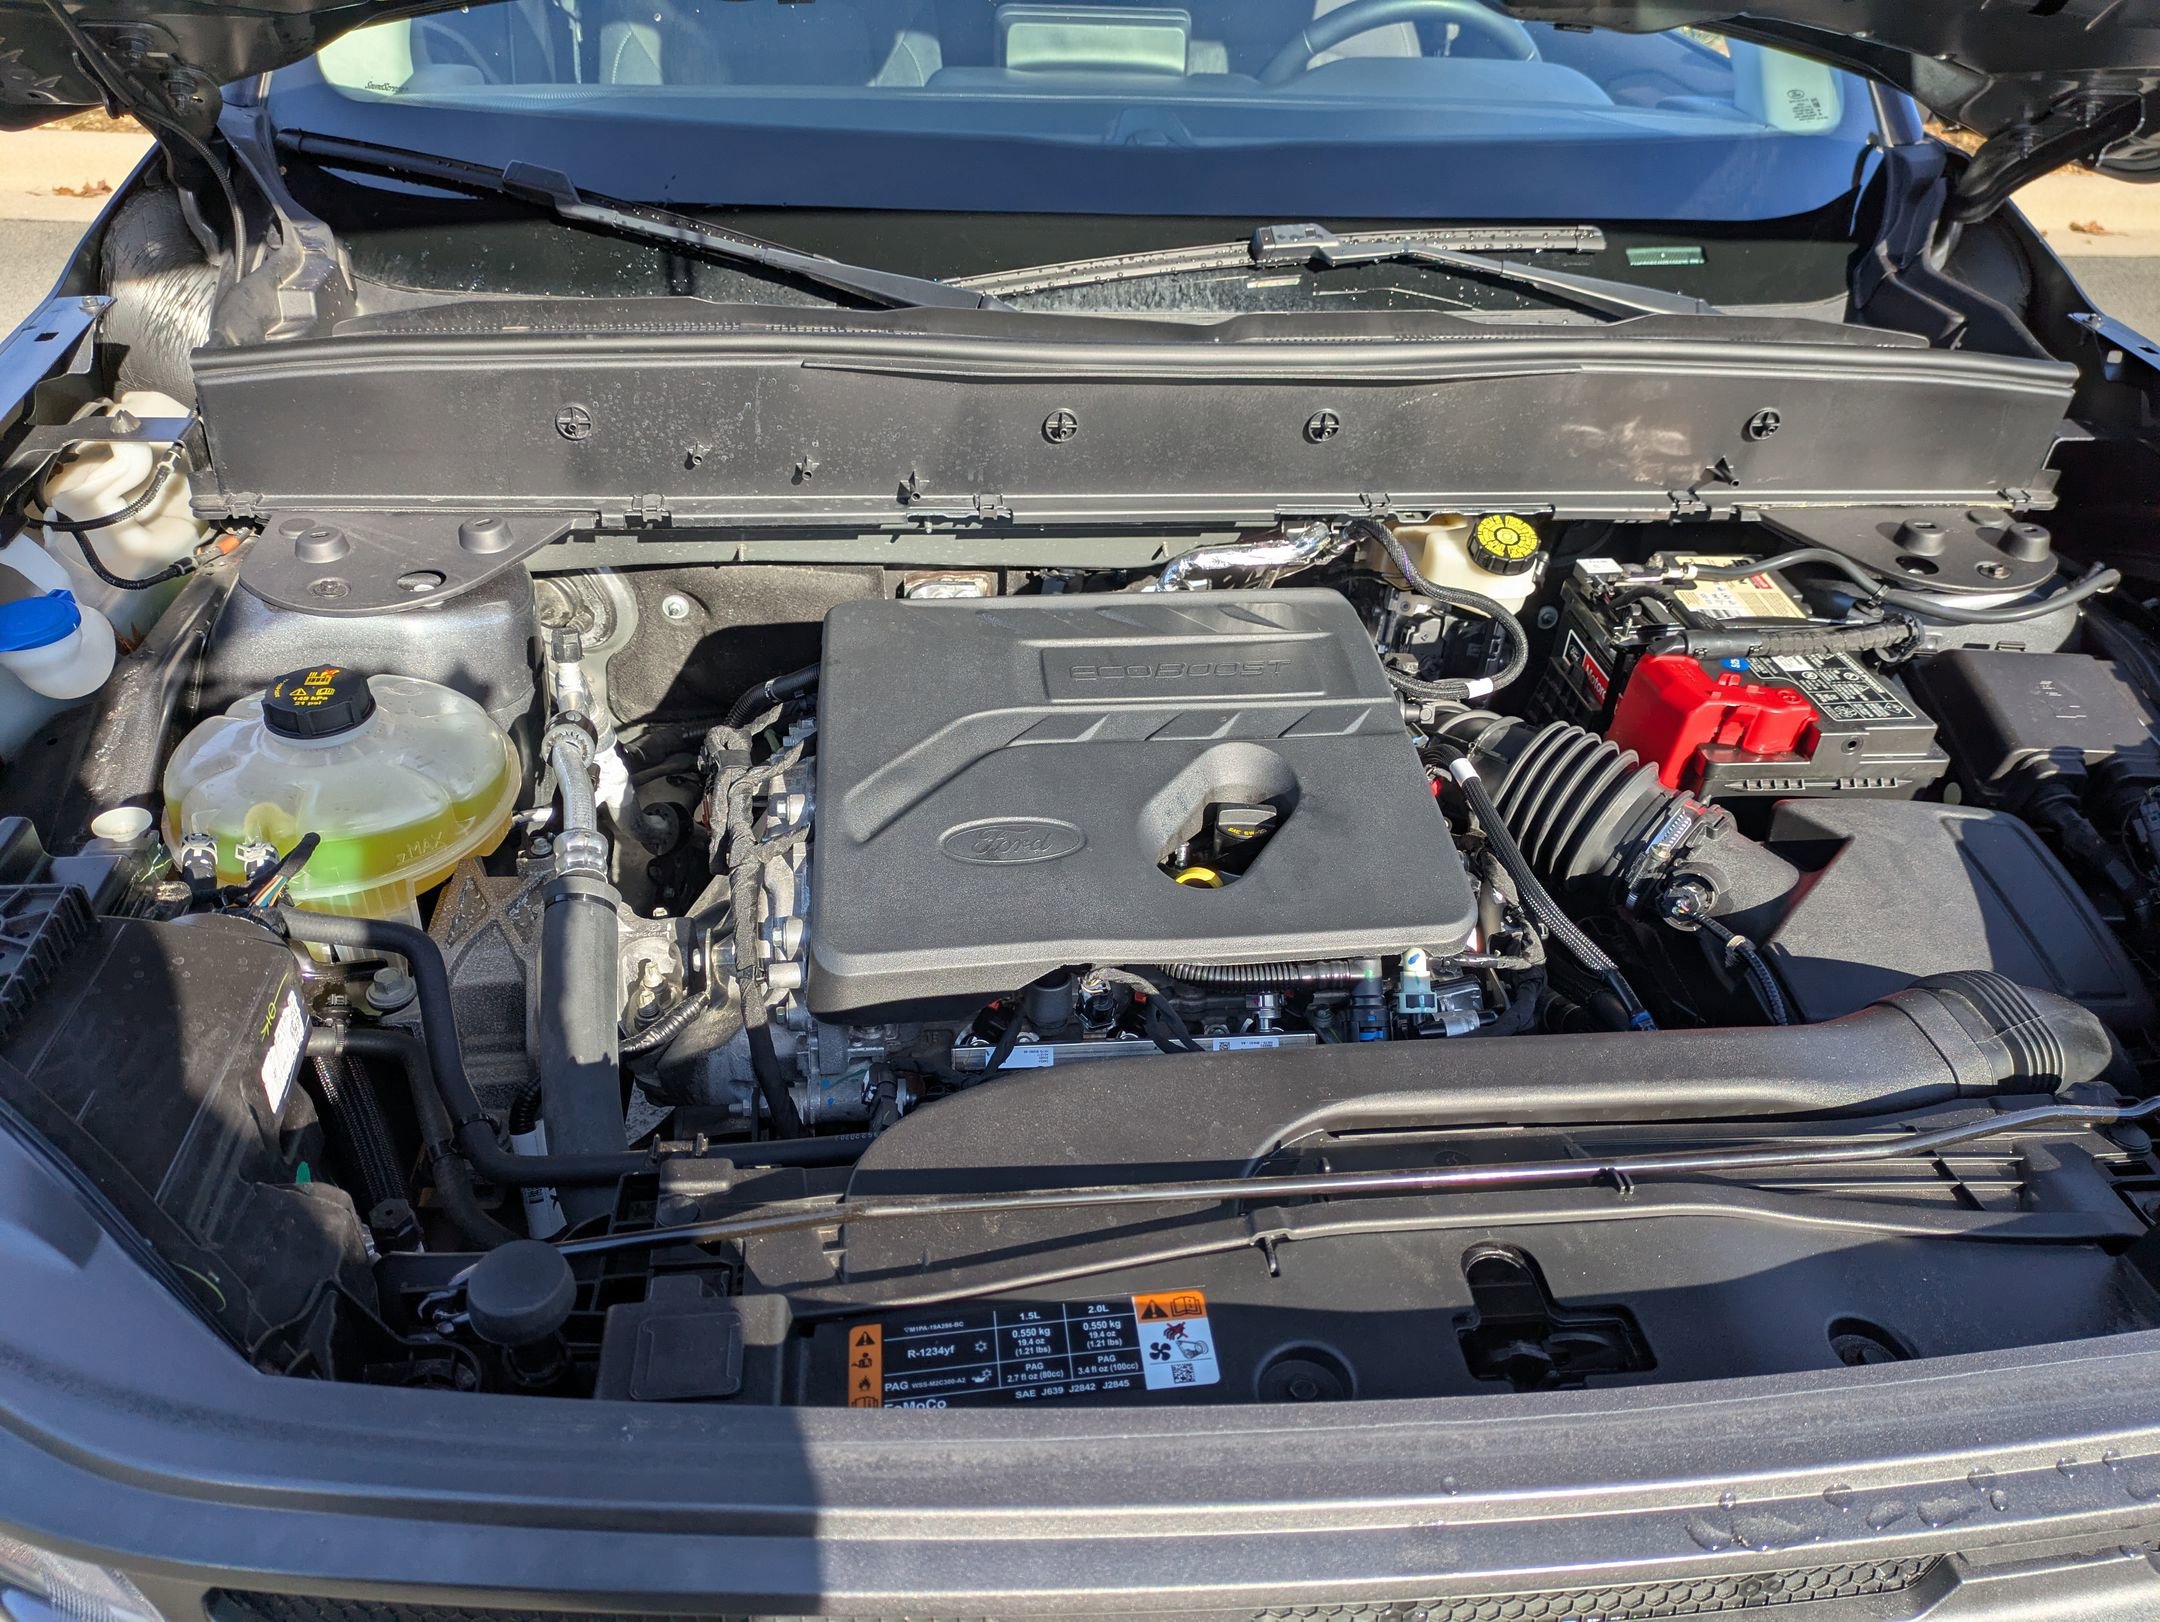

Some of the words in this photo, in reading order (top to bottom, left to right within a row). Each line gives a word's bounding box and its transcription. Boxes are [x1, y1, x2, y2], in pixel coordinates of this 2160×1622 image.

[972, 828, 1053, 855] Ford
[1087, 1304, 1110, 1314] 2.0L
[1019, 1311, 1041, 1321] 1.5L
[1082, 1321, 1107, 1331] 0.550
[1109, 1320, 1121, 1330] kg
[1012, 1328, 1037, 1339] 0.550
[1038, 1327, 1051, 1337] kg
[1088, 1331, 1105, 1339] 19.4
[1017, 1338, 1034, 1346] 19.4
[1086, 1340, 1106, 1350] (1.21
[1107, 1338, 1123, 1347] lbs)
[907, 1344, 956, 1359] R-1234yf
[1015, 1348, 1034, 1358] (1.21
[1035, 1345, 1052, 1354] lbs)
[1097, 1354, 1117, 1363] PAG
[1025, 1362, 1044, 1371] PAG
[1077, 1366, 1091, 1375] 3.4
[1098, 1365, 1109, 1373] oz
[1109, 1362, 1139, 1373] (100cc)
[1007, 1374, 1020, 1383] 2.7
[1021, 1373, 1028, 1381] fl
[1039, 1369, 1064, 1380] (80cc)
[884, 1381, 909, 1392] PAG
[1015, 1389, 1037, 1399] SAE
[1041, 1386, 1064, 1396] J639
[1068, 1383, 1096, 1393] J2842
[1102, 1380, 1130, 1390] J2845
